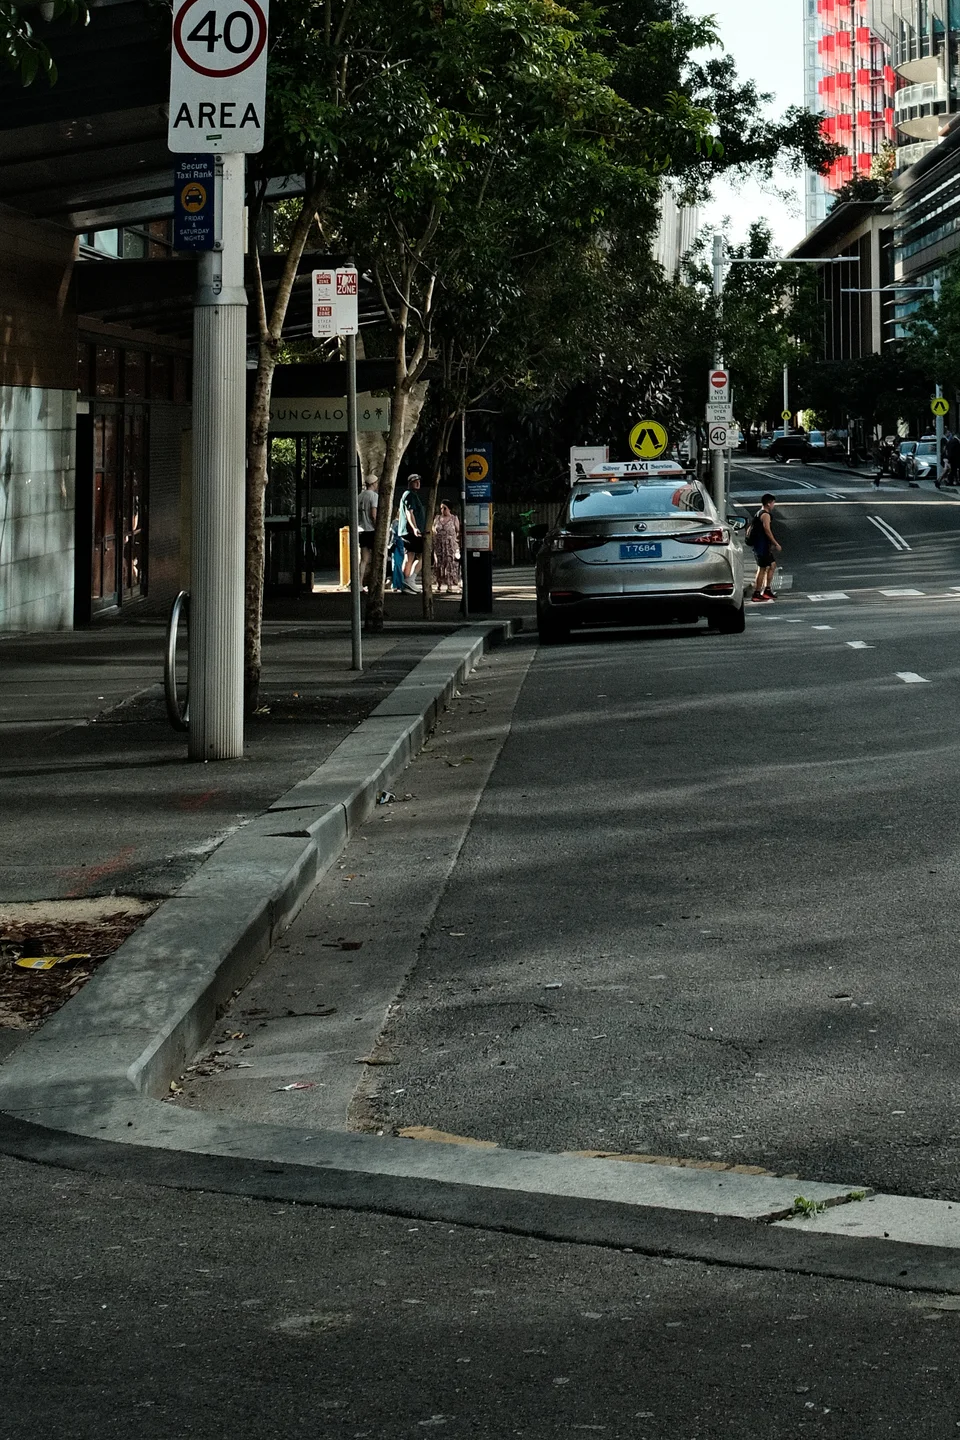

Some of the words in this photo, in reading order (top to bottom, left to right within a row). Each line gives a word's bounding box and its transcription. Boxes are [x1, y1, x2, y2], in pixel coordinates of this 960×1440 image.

[186, 10, 254, 54] 40
[172, 102, 261, 129] AREA
[181, 162, 208, 170] Secure
[176, 171, 192, 179] Taxi
[193, 170, 213, 178] Rank
[337, 274, 356, 284] TXI
[337, 285, 356, 294] ZONE
[269, 409, 345, 420] BUNGALO
[363, 409, 371, 420] 8
[712, 431, 727, 441] 40
[624, 463, 649, 471] TAXI
